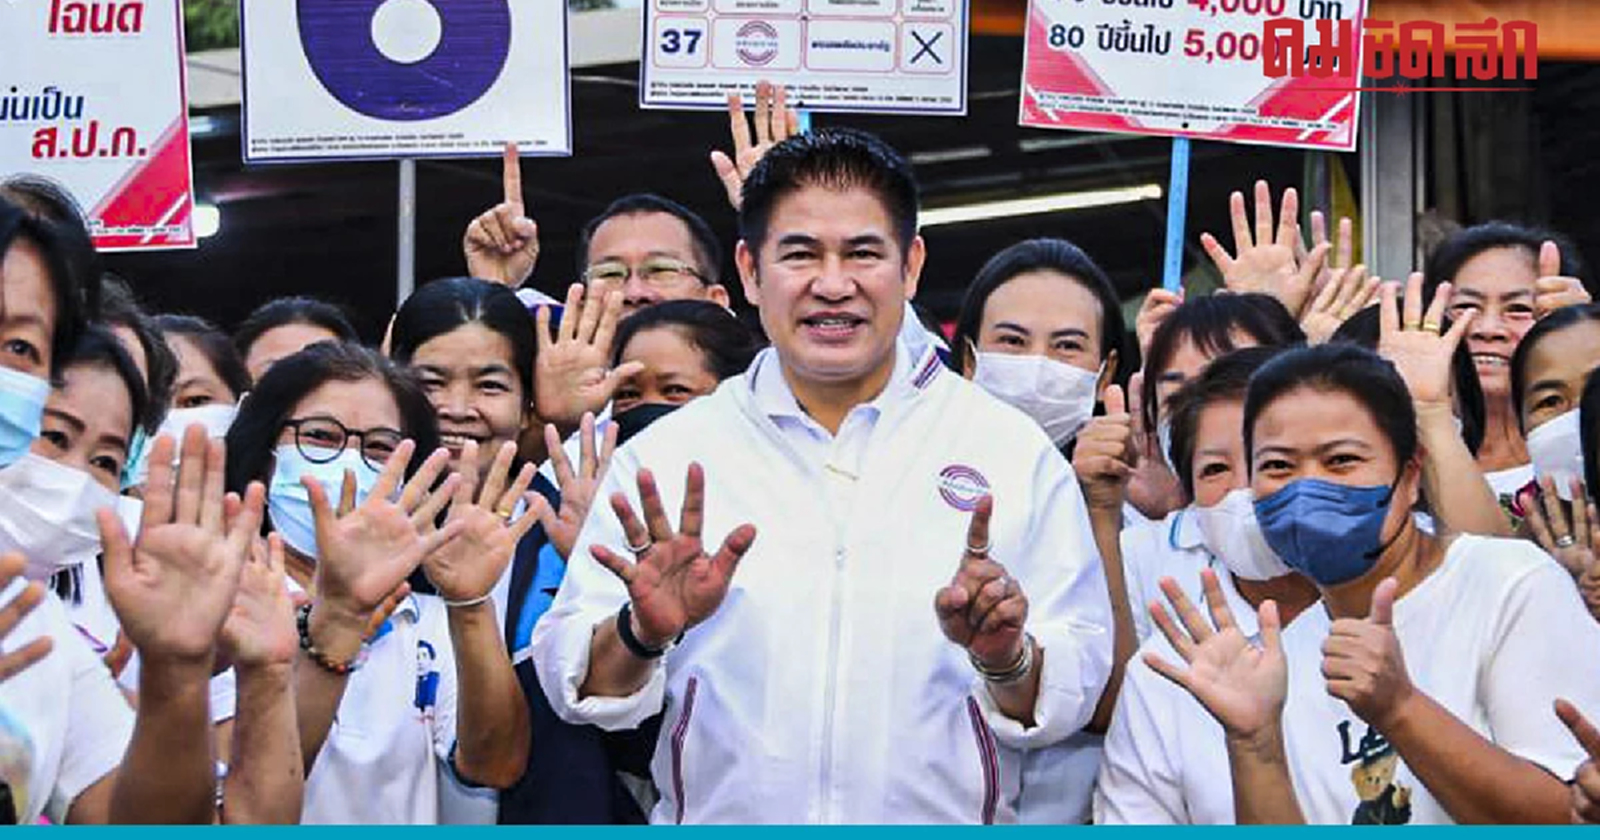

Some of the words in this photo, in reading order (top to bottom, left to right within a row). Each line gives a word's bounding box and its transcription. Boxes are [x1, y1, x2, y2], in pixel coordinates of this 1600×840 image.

[660, 28, 702, 54] 37
[1049, 24, 1085, 48] 80
[1095, 20, 1172, 55] ปีขึ้นไป
[1183, 28, 1280, 64] 5,00
[31, 120, 148, 159] ส.ป.ก.
